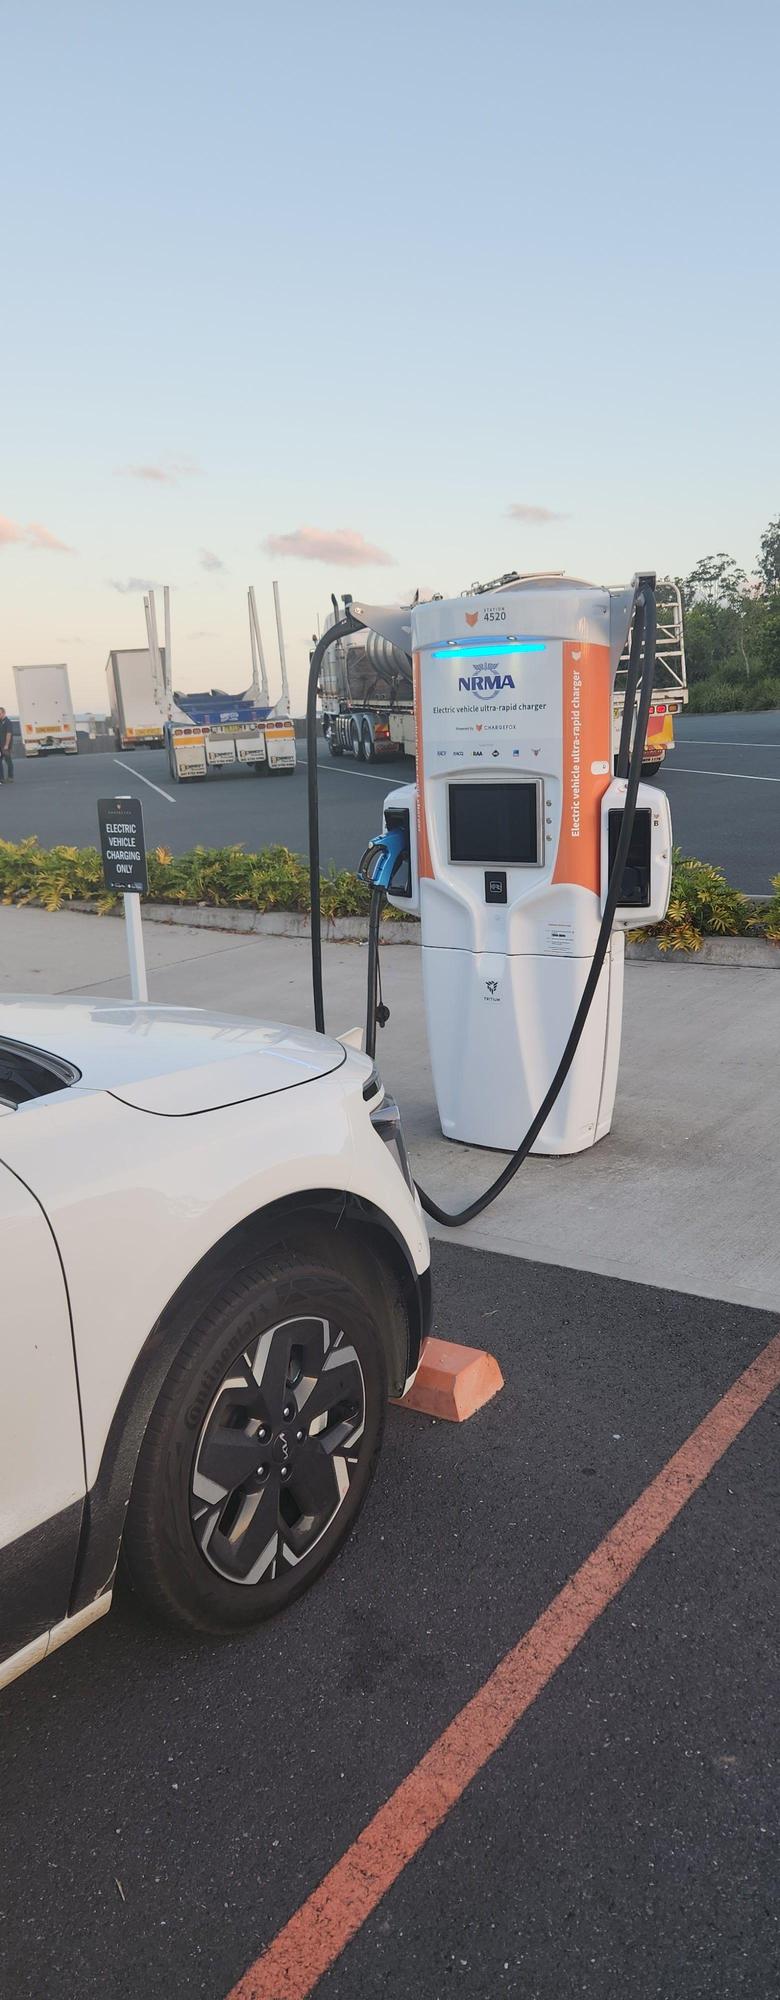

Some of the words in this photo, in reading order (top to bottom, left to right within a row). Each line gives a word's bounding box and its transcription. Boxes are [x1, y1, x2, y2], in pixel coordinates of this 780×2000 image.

[483, 612, 506, 621] 4520
[458, 675, 516, 692] NRMA
[571, 670, 582, 708] charger
[433, 706, 455, 714] Electric
[456, 705, 479, 713] vehicle
[480, 703, 517, 713] ultra-rapid
[518, 702, 547, 712] charger
[571, 710, 582, 763] ultra-rapid
[571, 764, 580, 800] vehicle
[571, 800, 580, 837] Electric
[105, 823, 137, 833] ELECTRIC
[108, 837, 136, 847] VEHICLE
[106, 850, 140, 861] CHARGING
[116, 863, 133, 873] ONLY
